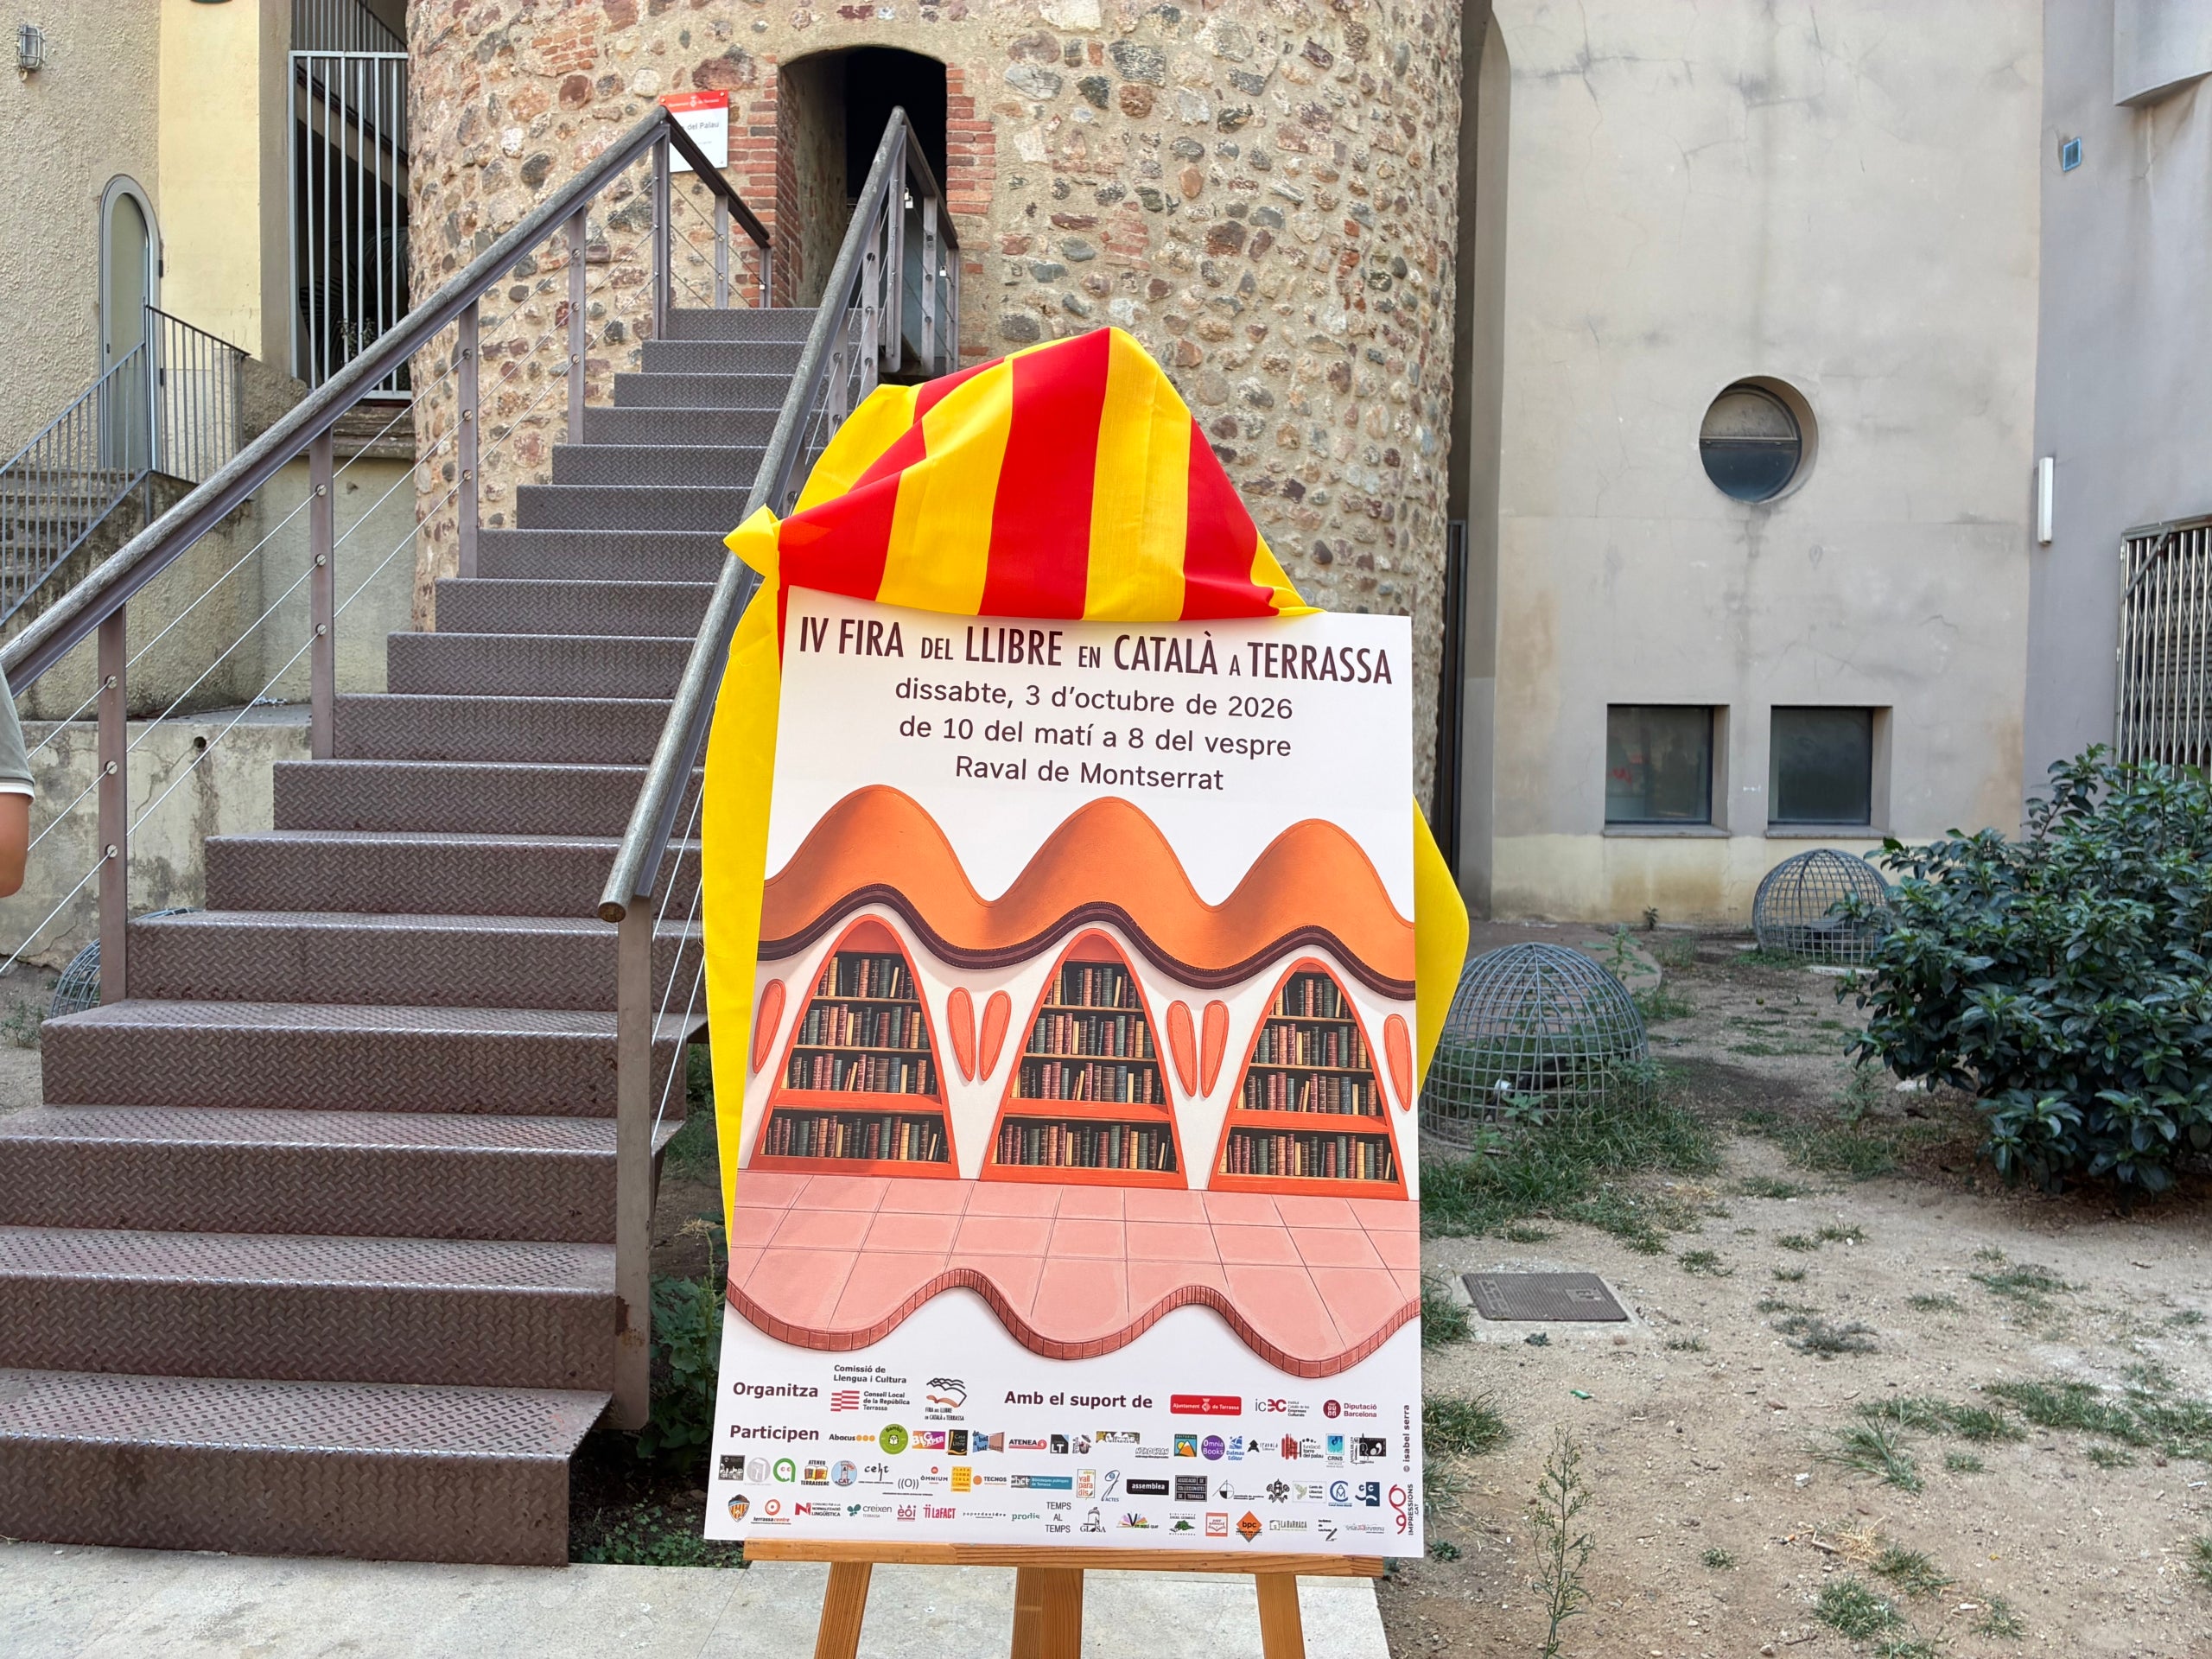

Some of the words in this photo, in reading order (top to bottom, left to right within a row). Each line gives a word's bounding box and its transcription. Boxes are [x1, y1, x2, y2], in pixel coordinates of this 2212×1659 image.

[799, 616, 830, 653] IV
[838, 620, 904, 658] FIRA
[921, 637, 954, 661] DEL
[965, 626, 1064, 666] LLIBRE
[1078, 645, 1101, 669] EN
[1114, 631, 1218, 675] CATALÀ
[1229, 654, 1241, 677] A
[1247, 641, 1392, 684] TERRASSA
[895, 677, 1014, 709] dissabte,
[1026, 684, 1040, 706] 3
[1185, 693, 1217, 715] de
[1228, 696, 1293, 720] 2026
[899, 715, 931, 738] de
[944, 718, 974, 740] 10
[984, 720, 1023, 742] del
[1034, 723, 1094, 747] matí
[1103, 731, 1116, 747] a
[1128, 728, 1144, 749] 8
[1155, 728, 1193, 752] del
[1205, 736, 1292, 760] vespre
[956, 755, 1027, 780] Raval
[1038, 760, 1070, 782] de
[1081, 762, 1224, 791] Montserrat
[834, 1364, 873, 1374] Comissió
[874, 1365, 886, 1374] de
[833, 1374, 868, 1383] Llengua
[733, 1381, 819, 1400] Organitza
[1004, 1390, 1044, 1405] Amb
[1049, 1392, 1065, 1406] el
[1070, 1395, 1127, 1410] suport
[1131, 1395, 1153, 1408] de
[730, 1425, 819, 1443] Participen
[1203, 1439, 1224, 1447] Omnia
[862, 1503, 893, 1513] creixen
[1046, 1501, 1072, 1510] TEMPS
[1045, 1524, 1071, 1533] TEMPS
